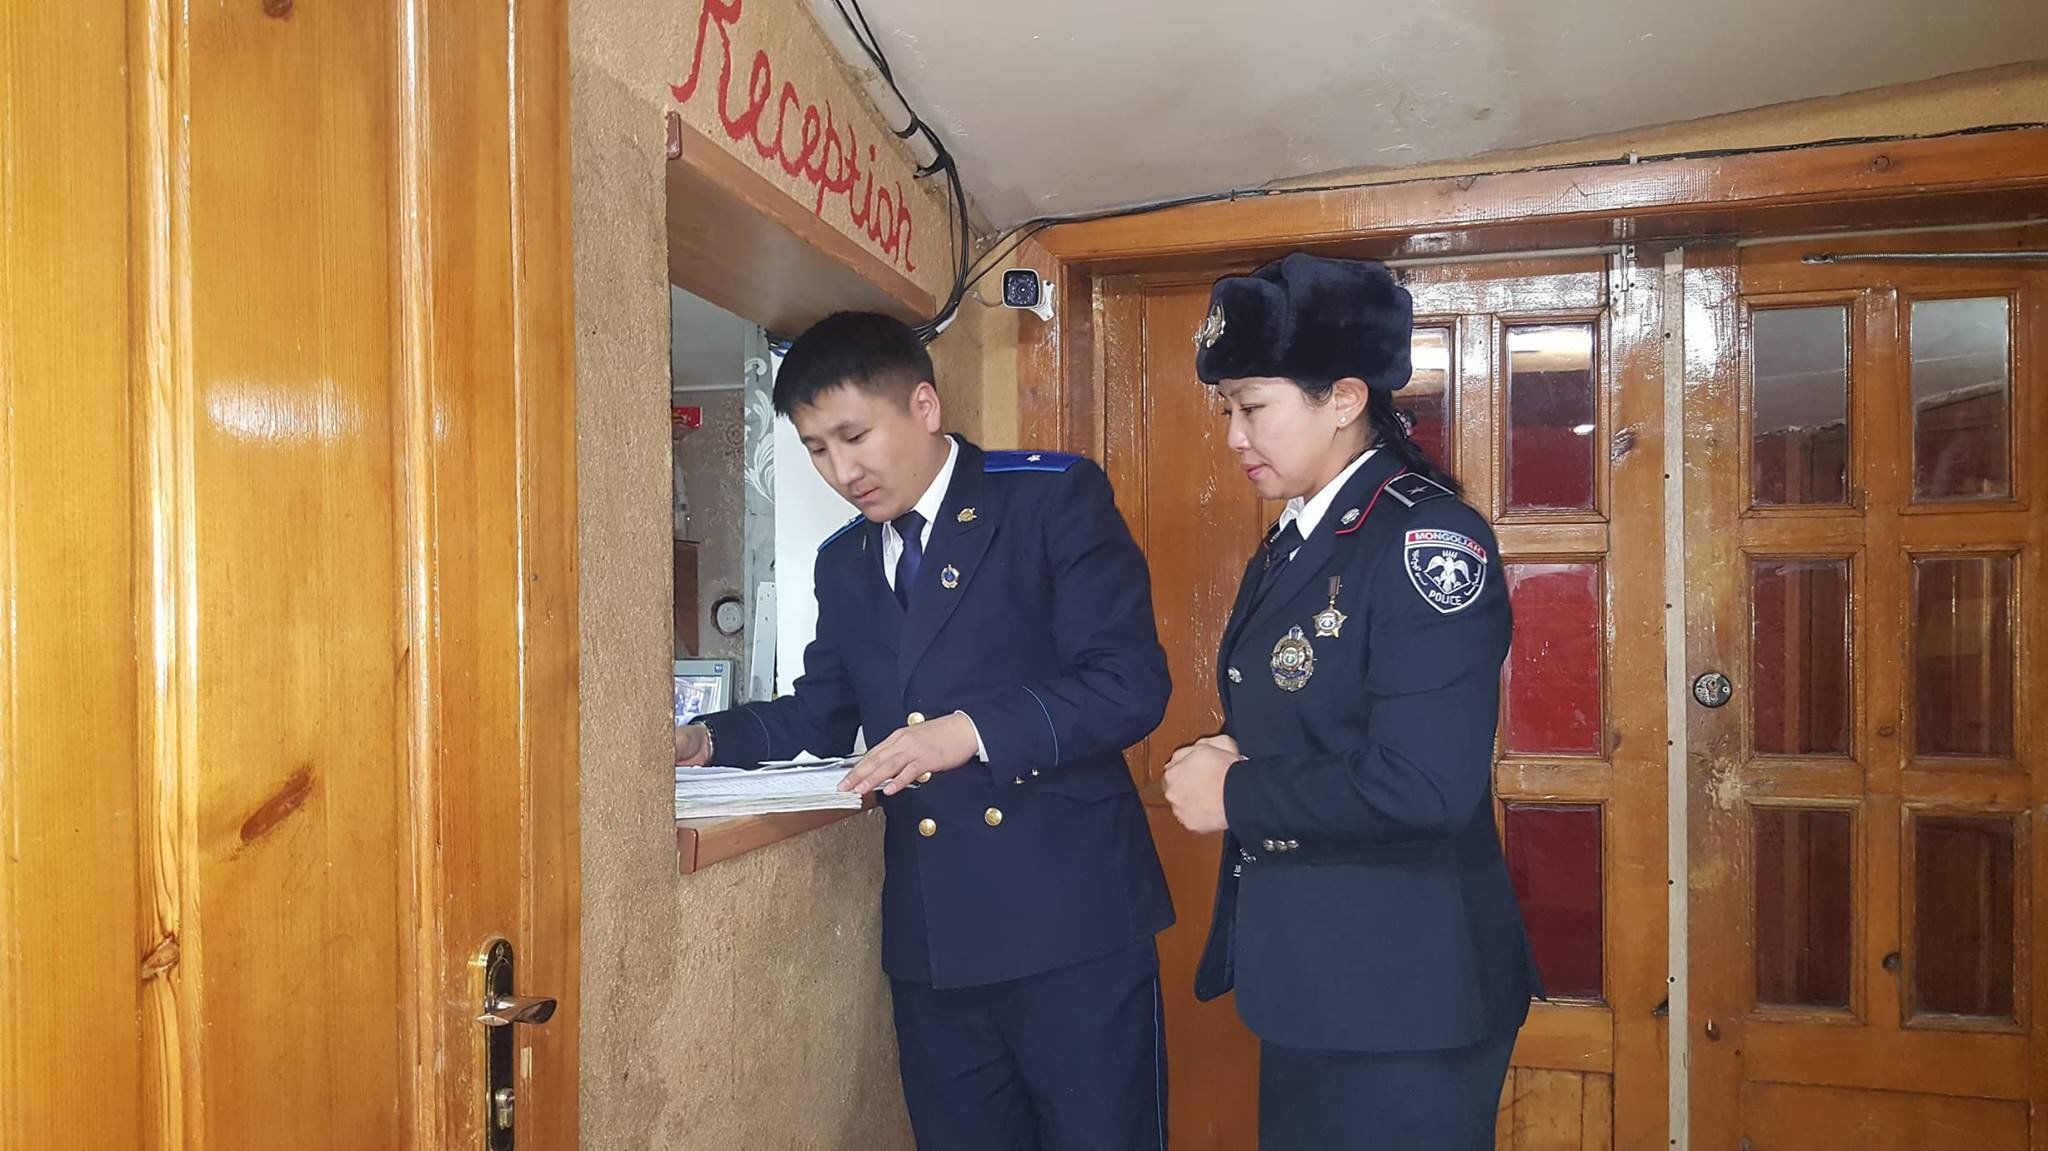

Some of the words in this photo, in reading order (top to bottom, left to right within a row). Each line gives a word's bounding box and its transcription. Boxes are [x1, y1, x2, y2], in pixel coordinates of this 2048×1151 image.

[668, 0, 915, 272] Reception
[1415, 531, 1483, 554] MONGOLIAN
[1428, 589, 1462, 606] POLICE
